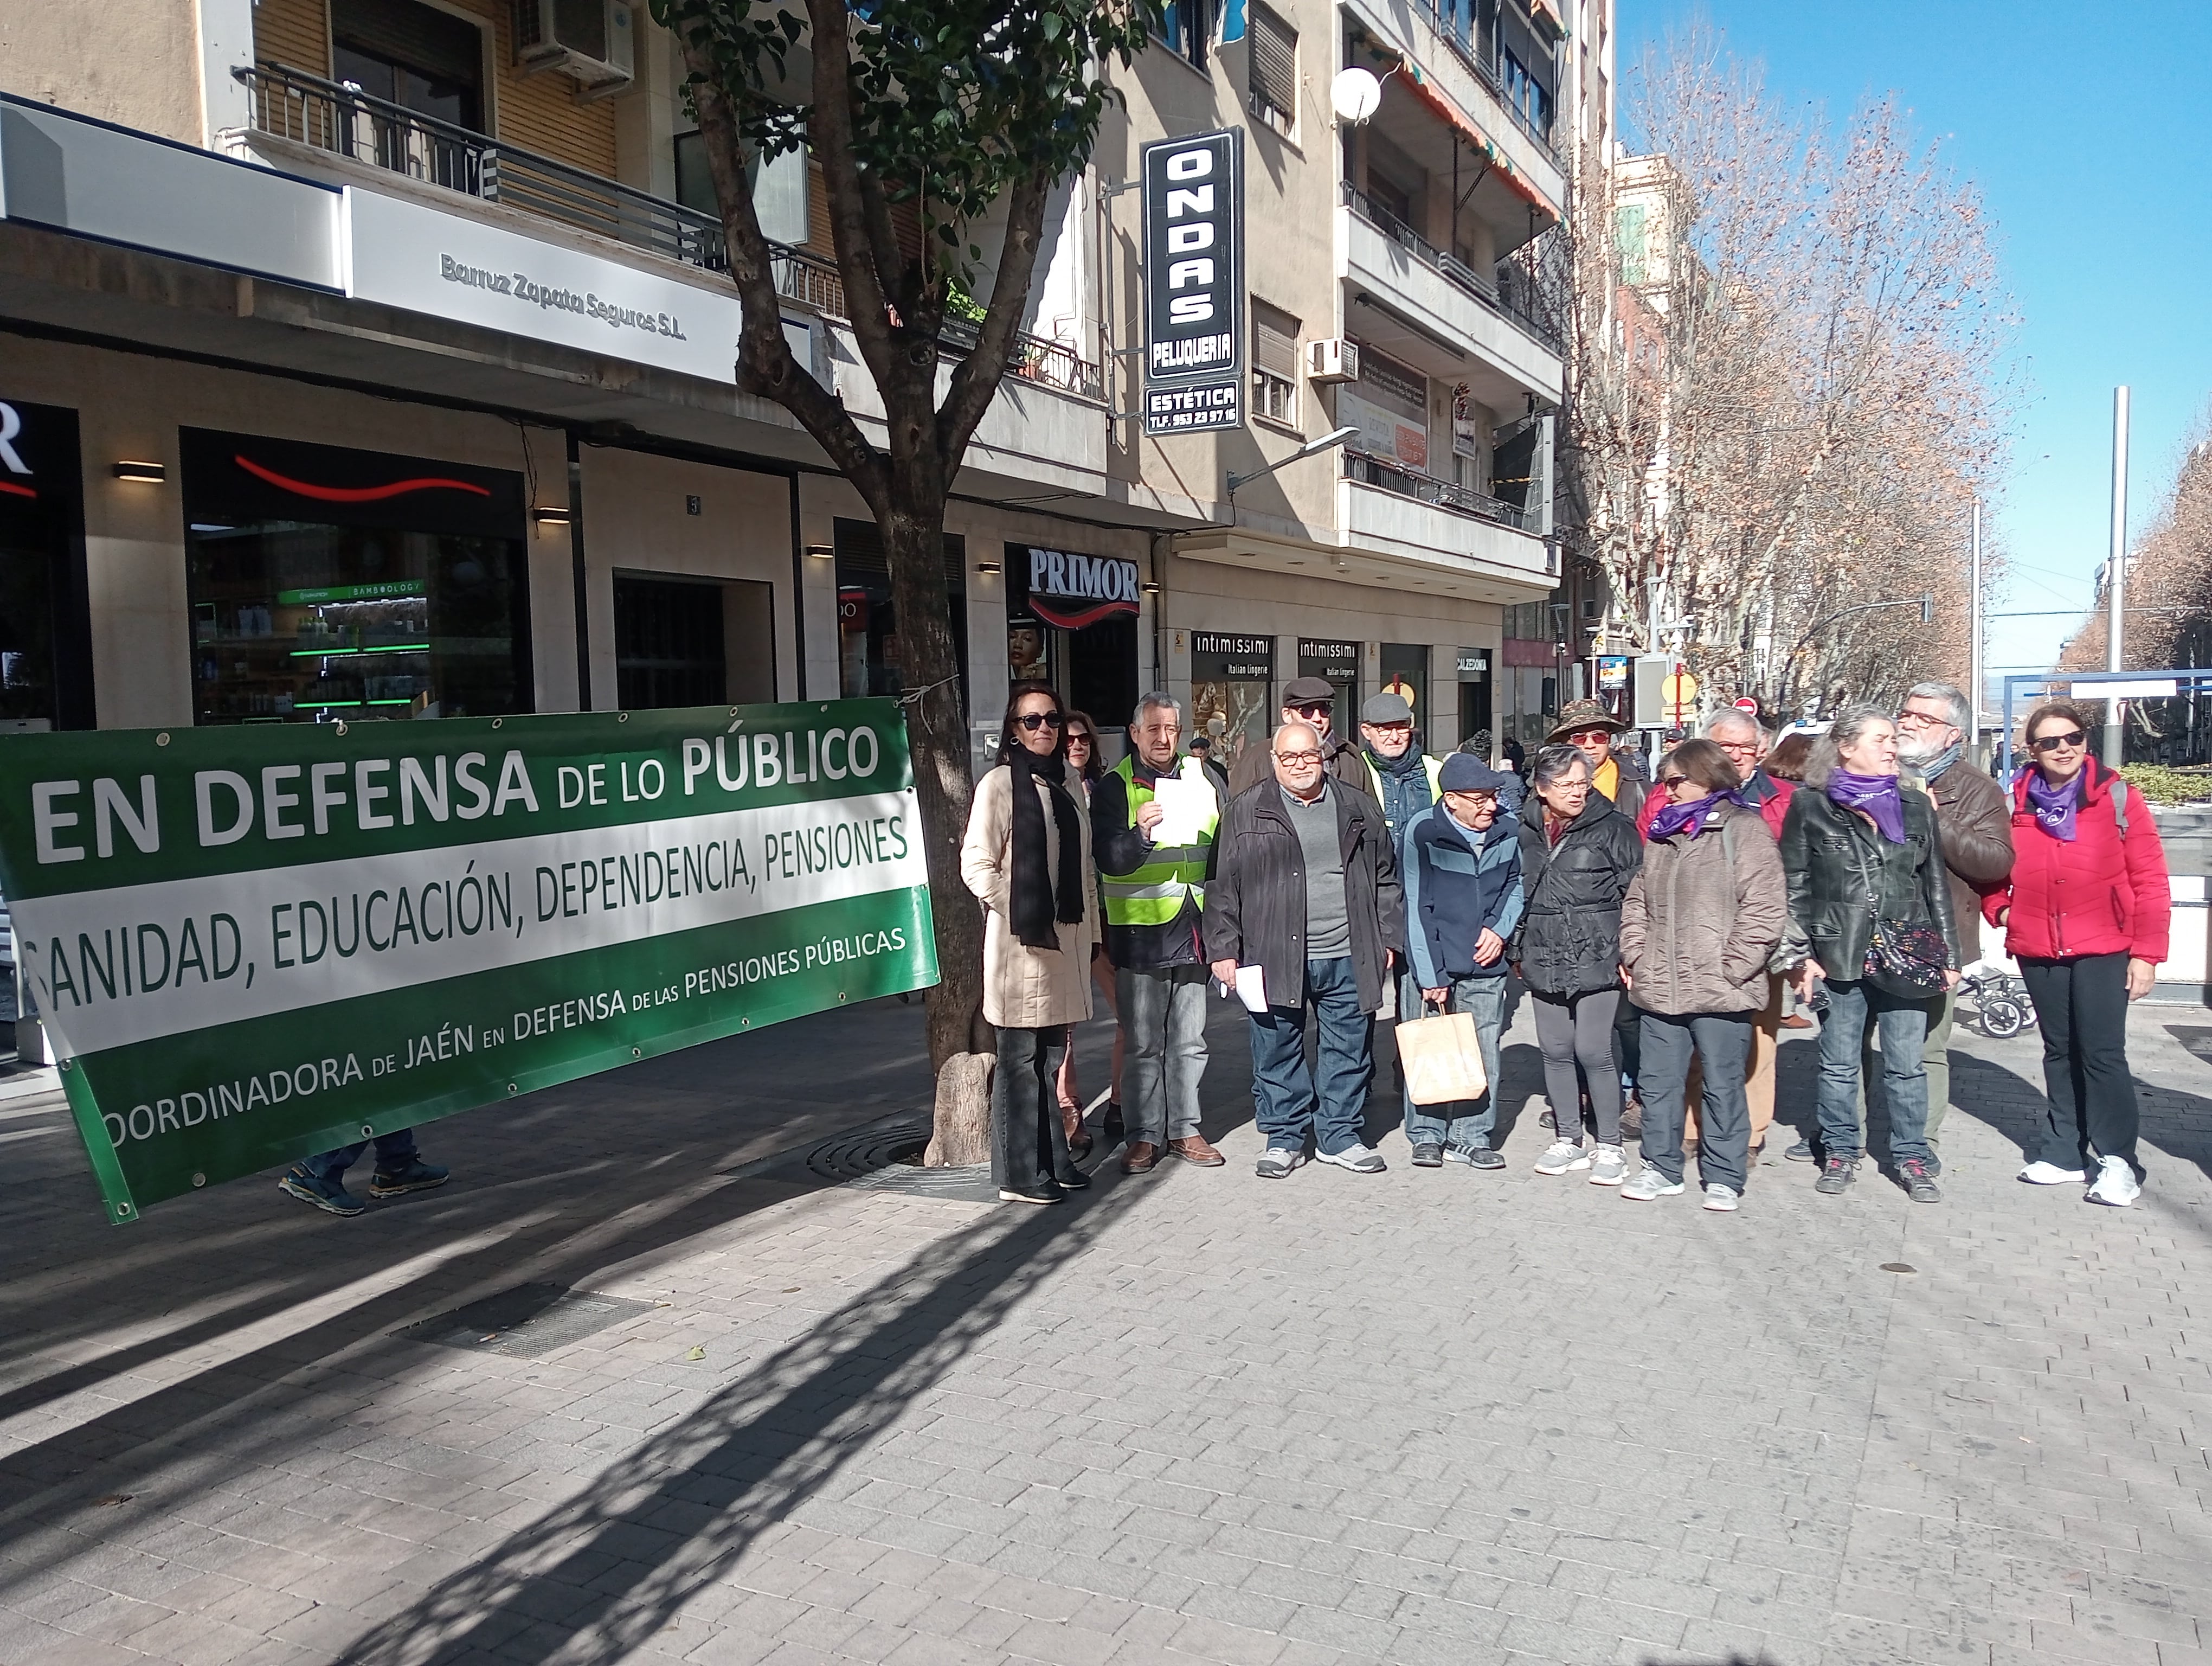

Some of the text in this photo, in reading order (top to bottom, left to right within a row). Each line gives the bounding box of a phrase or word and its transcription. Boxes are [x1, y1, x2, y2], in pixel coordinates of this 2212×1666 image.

[1166, 148, 1214, 325] ONDAS
[440, 252, 511, 296] Barruz
[512, 272, 584, 313] Zapata
[586, 292, 657, 332] Seguros
[1153, 334, 1231, 369] PELUQUERIA
[1150, 387, 1235, 413] ESTÉTICA
[1150, 408, 1236, 428] TLF. 953 23 97 16
[1028, 548, 1140, 601] PRIMOR
[1197, 634, 1268, 654] intimissimi
[1300, 641, 1355, 658] intimissimi
[1228, 663, 1246, 674] Italian
[31, 719, 879, 864] EN DEFENSA DE LO PÚBLICO
[272, 860, 523, 969] EDUCACIÓN,
[536, 838, 756, 923] DEPENDENCIA,
[764, 816, 908, 882] PENSIONES
[101, 927, 906, 1149] OORDINADORA DE JAÉN EN DEFENSA DE LAS PENSIONES PÚBLICAS
